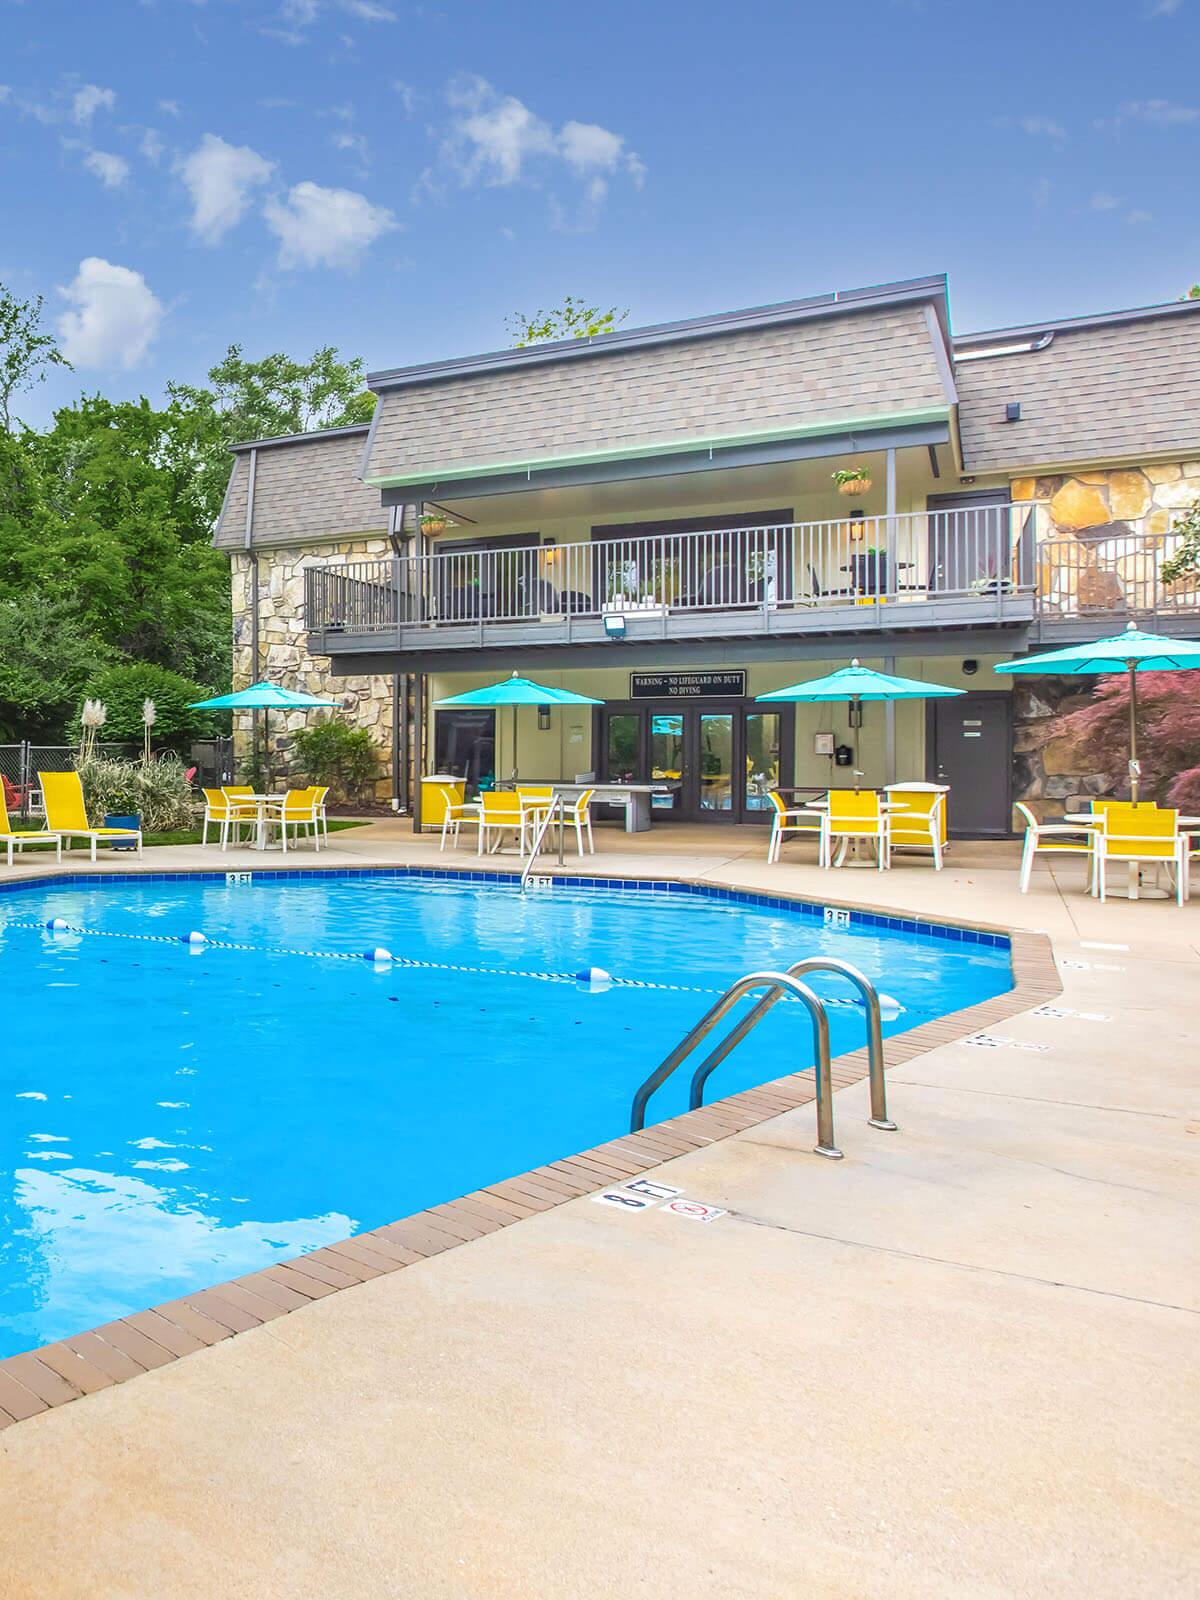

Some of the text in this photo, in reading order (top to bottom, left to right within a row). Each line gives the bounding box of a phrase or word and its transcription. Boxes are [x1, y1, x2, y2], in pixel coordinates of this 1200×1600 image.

[635, 677, 663, 686] WARNING
[669, 677, 678, 685] NO
[679, 675, 712, 685] LIFEGUARD
[713, 675, 722, 684] ON
[723, 675, 741, 684] DUTY
[669, 686, 701, 695] NO DIVING
[527, 877, 551, 888] 3 FT
[827, 910, 849, 924] 3 FT
[603, 1180, 678, 1208] 8 FT
